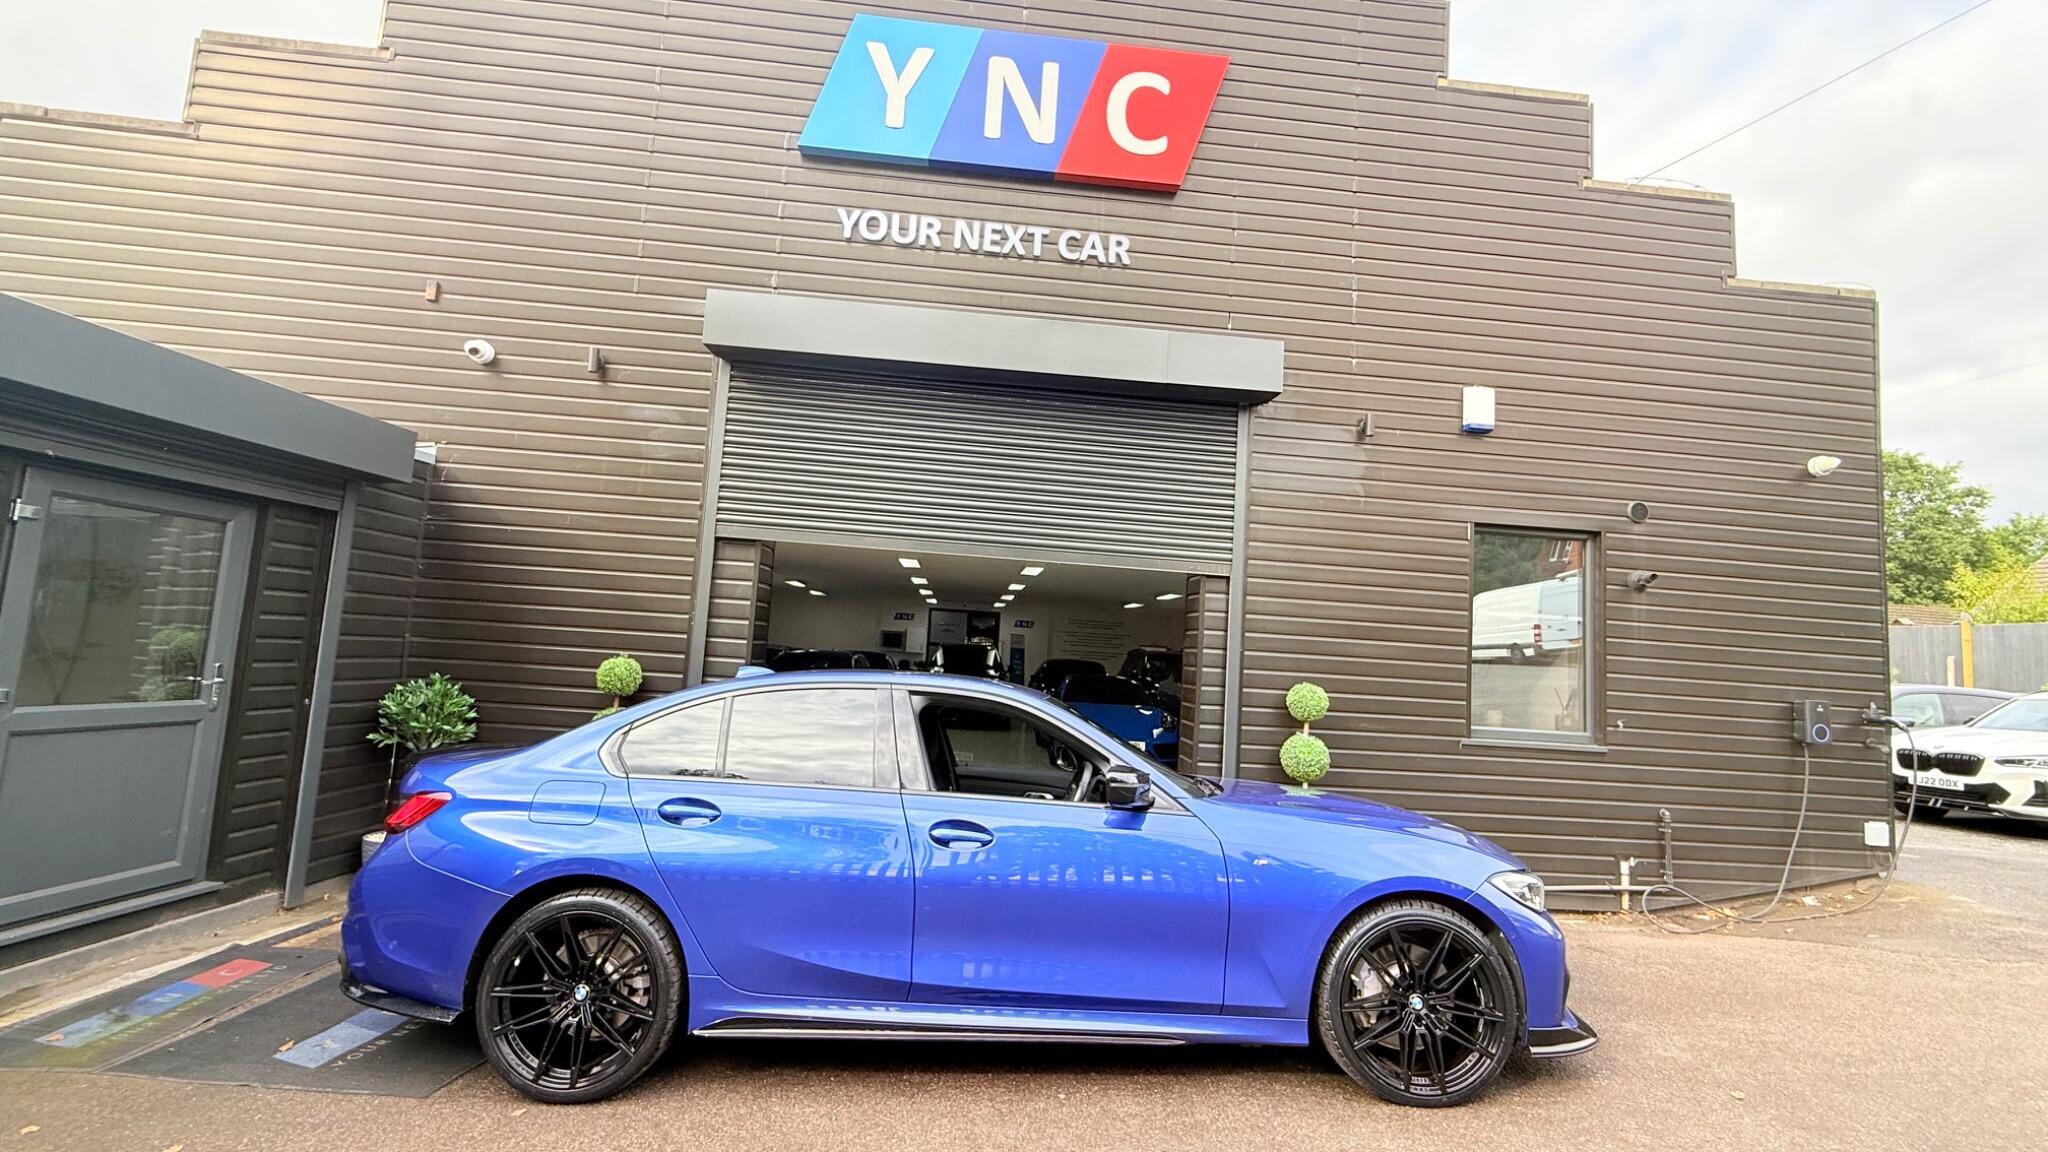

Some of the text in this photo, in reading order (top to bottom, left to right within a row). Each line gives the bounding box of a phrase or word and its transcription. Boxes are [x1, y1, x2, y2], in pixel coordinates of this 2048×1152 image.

[866, 41, 1171, 155] YNC
[837, 207, 1132, 267] YOUR NEXT CAR
[329, 1039, 392, 1067] YOUR
